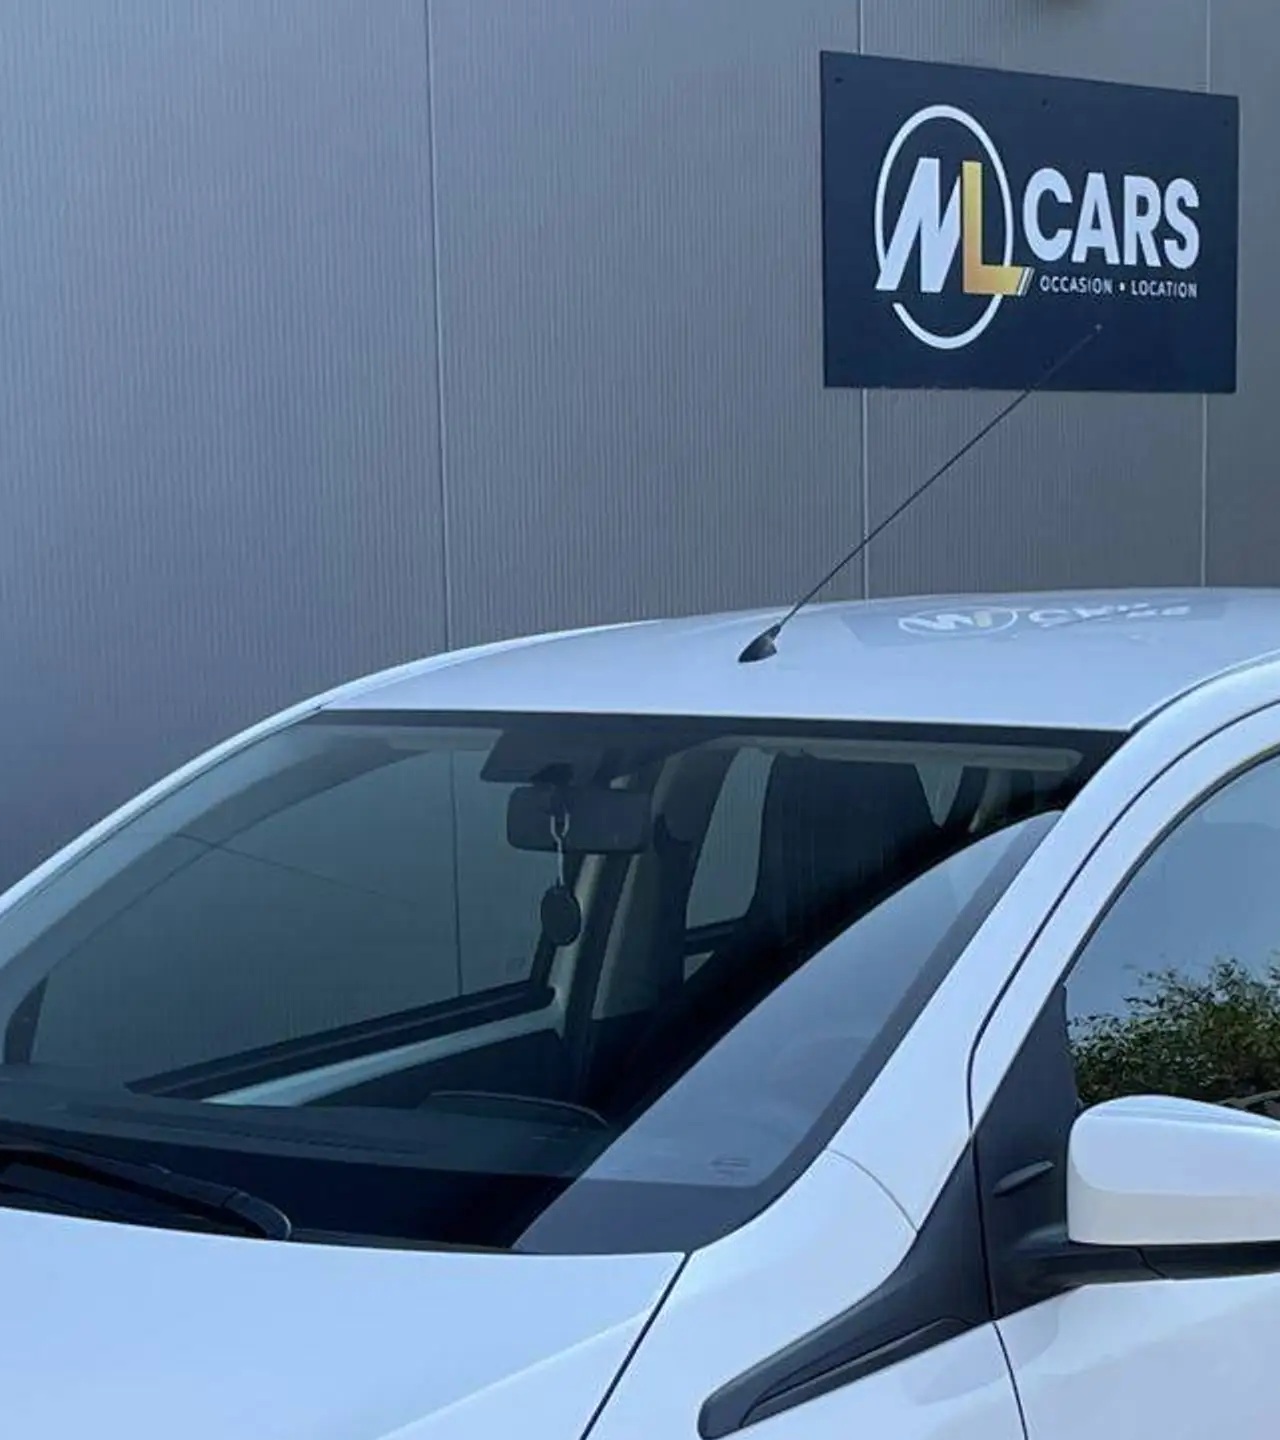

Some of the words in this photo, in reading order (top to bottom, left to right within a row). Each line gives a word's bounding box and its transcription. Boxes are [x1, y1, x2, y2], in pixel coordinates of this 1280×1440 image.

[1022, 167, 1200, 270] CARS
[1039, 274, 1113, 295] OCCASION
[1130, 278, 1198, 299] LOCATION
